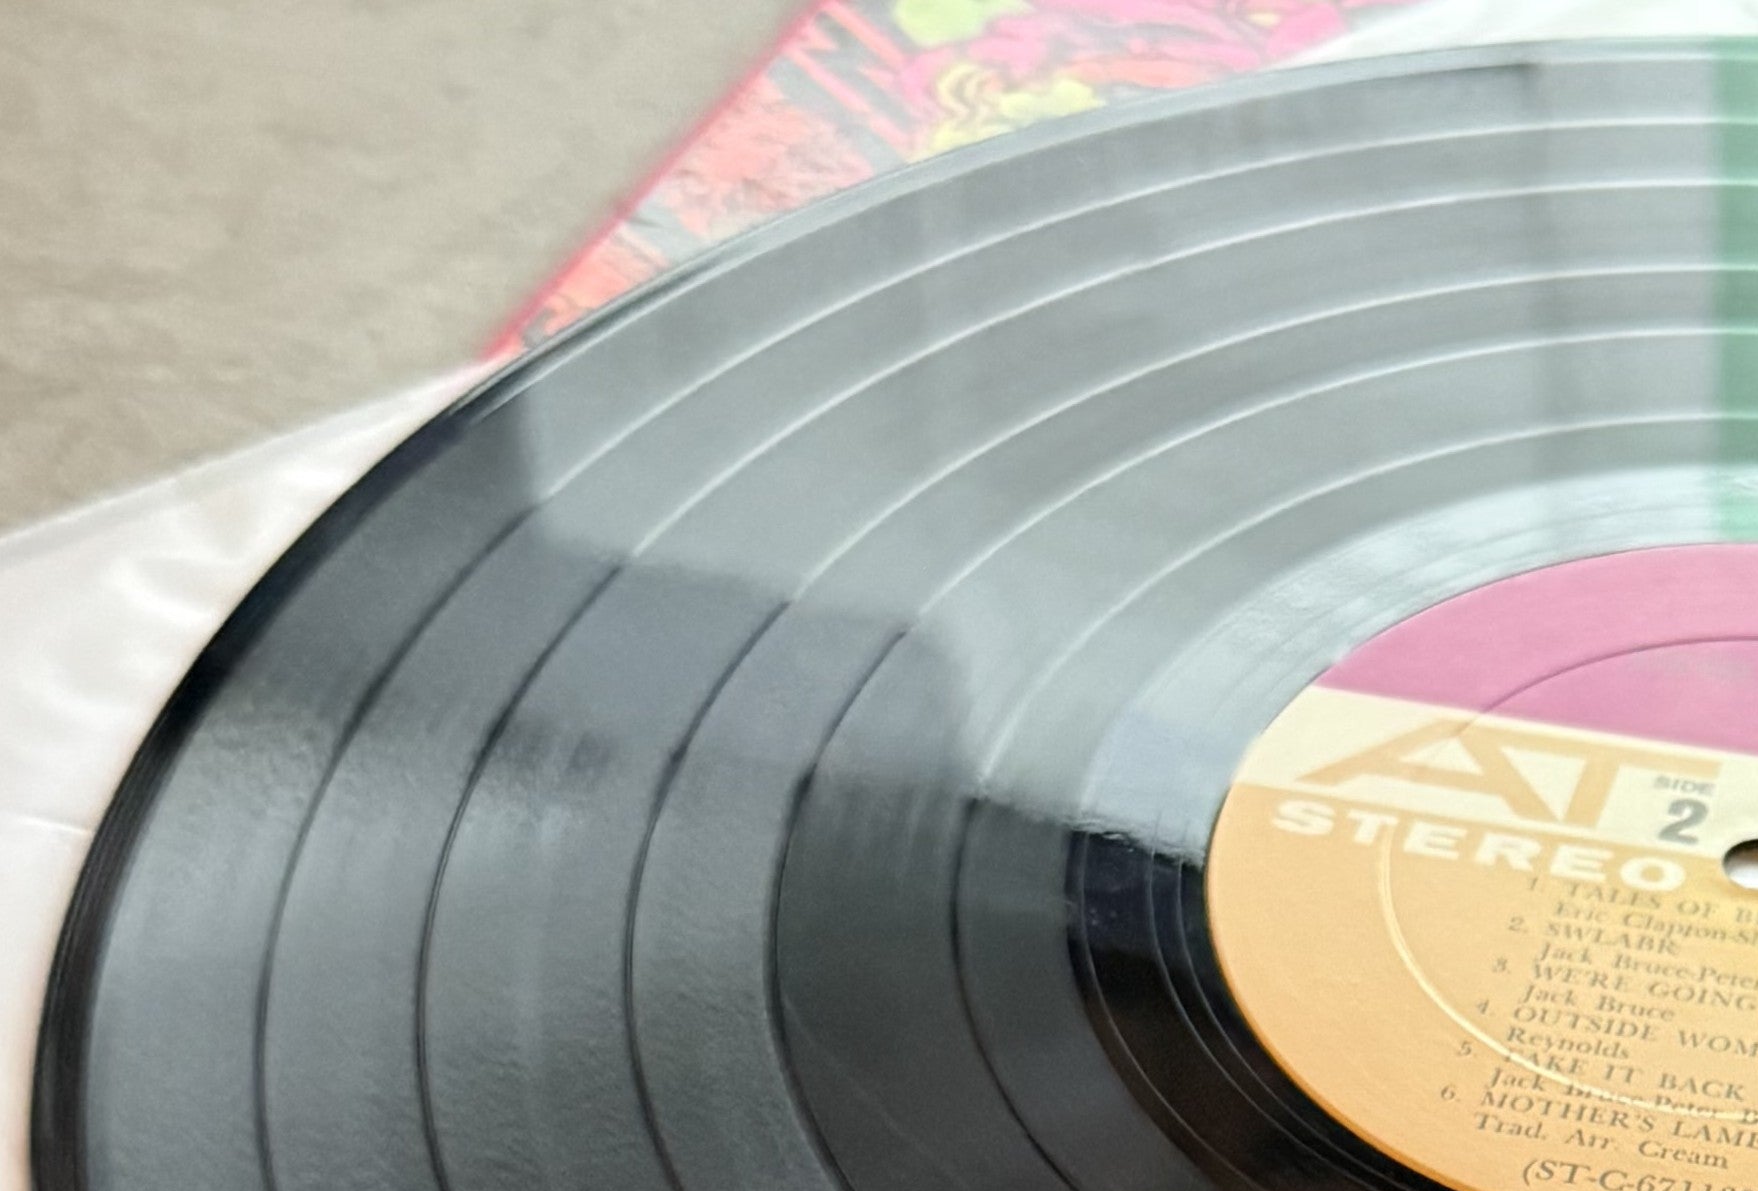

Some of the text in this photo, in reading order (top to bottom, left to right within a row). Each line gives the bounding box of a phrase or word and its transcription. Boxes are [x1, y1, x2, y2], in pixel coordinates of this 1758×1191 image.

[1653, 775, 1717, 797] SIDE
[1658, 798, 1710, 845] 2
[1271, 801, 1687, 891] STEREO
[1555, 900, 1608, 924] Eric
[1567, 881, 1662, 910] TALES
[1677, 899, 1719, 919] OF
[1540, 941, 1592, 965] Jack
[1548, 921, 1679, 956] SWLABR
[1521, 984, 1676, 1022] Jack Bruce
[1531, 960, 1631, 991] WE'RE
[1648, 981, 1757, 1012] GOING
[1512, 1005, 1660, 1042] OUTSIDE
[1507, 1026, 1631, 1060] Reynolds
[1490, 1067, 1545, 1092] Jack
[1604, 1064, 1644, 1085] IT
[1658, 1072, 1745, 1102] BACK
[1481, 1090, 1656, 1133] MOTHER'S
[1474, 1111, 1549, 1141] Trad.
[1638, 1139, 1729, 1170] Cream
